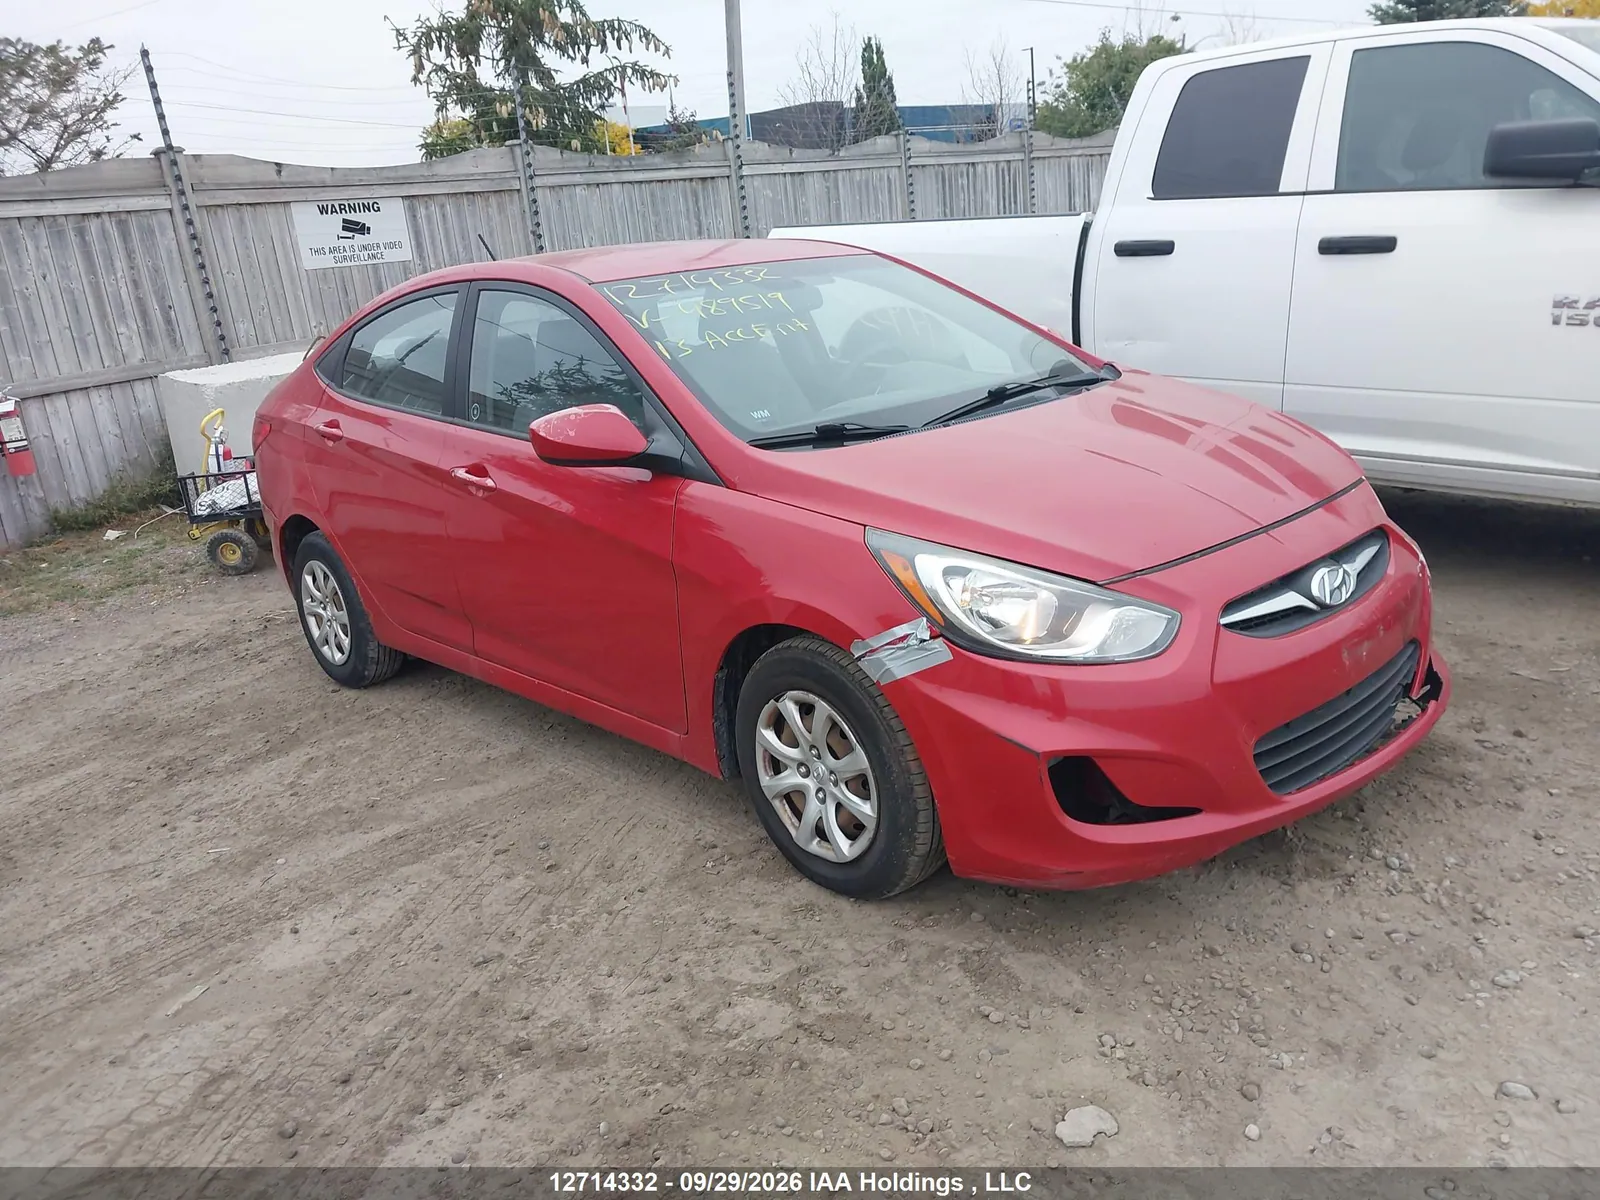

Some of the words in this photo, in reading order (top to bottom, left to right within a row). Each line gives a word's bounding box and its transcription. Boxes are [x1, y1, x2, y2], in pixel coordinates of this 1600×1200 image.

[317, 201, 381, 215] WARNING
[309, 246, 327, 257] THIS
[328, 245, 347, 255] AREA
[348, 244, 356, 254] IS
[357, 242, 381, 253] UNDER
[382, 240, 403, 251] VIDEO
[333, 252, 385, 265] SURVEILLANCE
[1551, 310, 1600, 328] 15
[750, 409, 771, 419] WM
